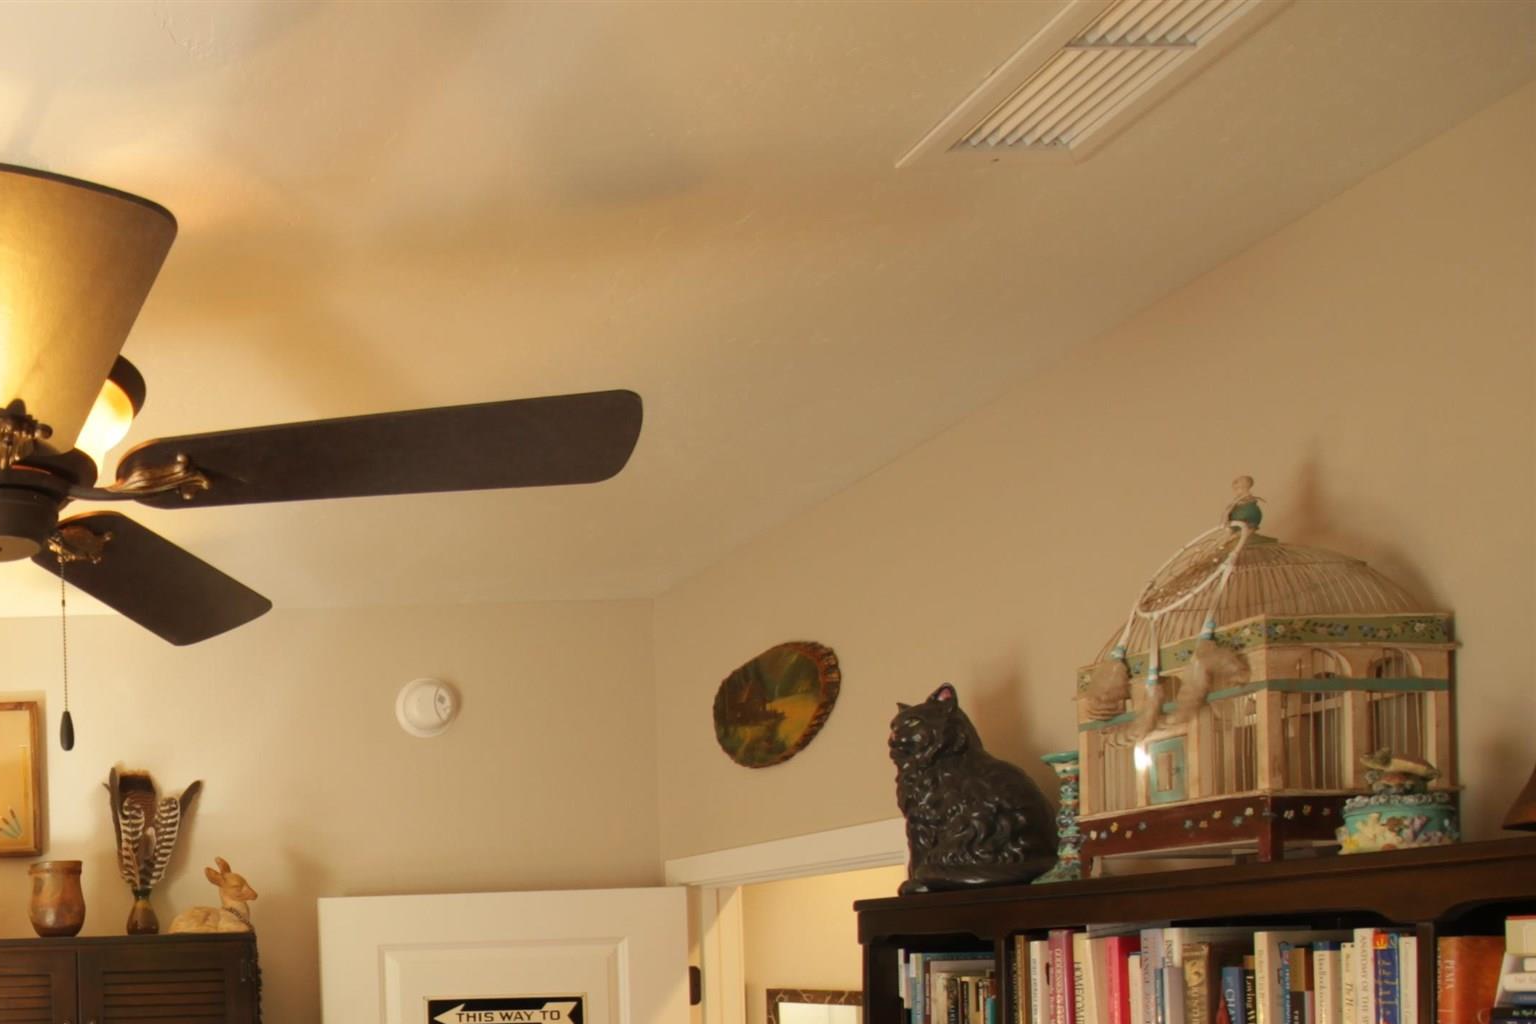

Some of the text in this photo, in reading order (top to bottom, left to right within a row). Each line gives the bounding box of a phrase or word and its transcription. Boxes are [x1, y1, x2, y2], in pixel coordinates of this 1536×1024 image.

[456, 1010, 561, 1023] THIS WAY TO
